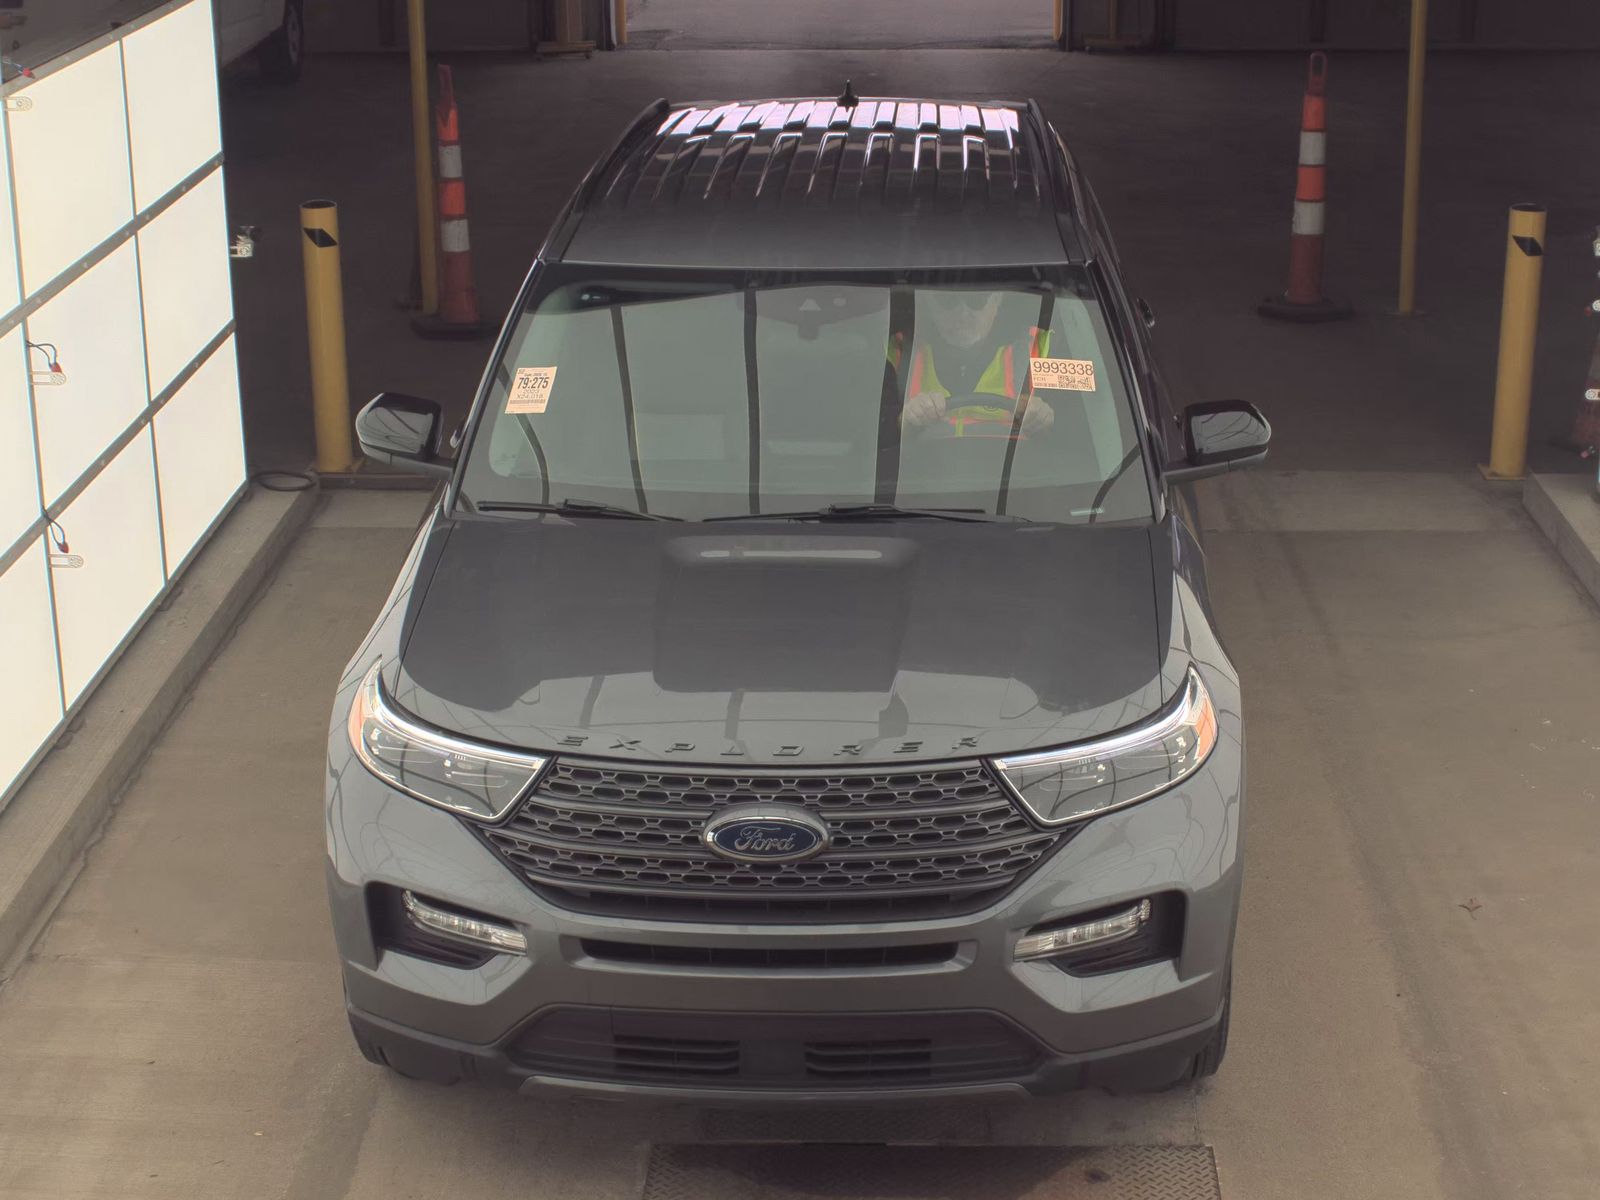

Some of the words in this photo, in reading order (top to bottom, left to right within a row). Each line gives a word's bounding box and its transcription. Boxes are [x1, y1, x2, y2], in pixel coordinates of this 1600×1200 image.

[1033, 361, 1093, 376] 9993338
[557, 736, 978, 756] EXPLORER
[734, 826, 796, 851] Ford
